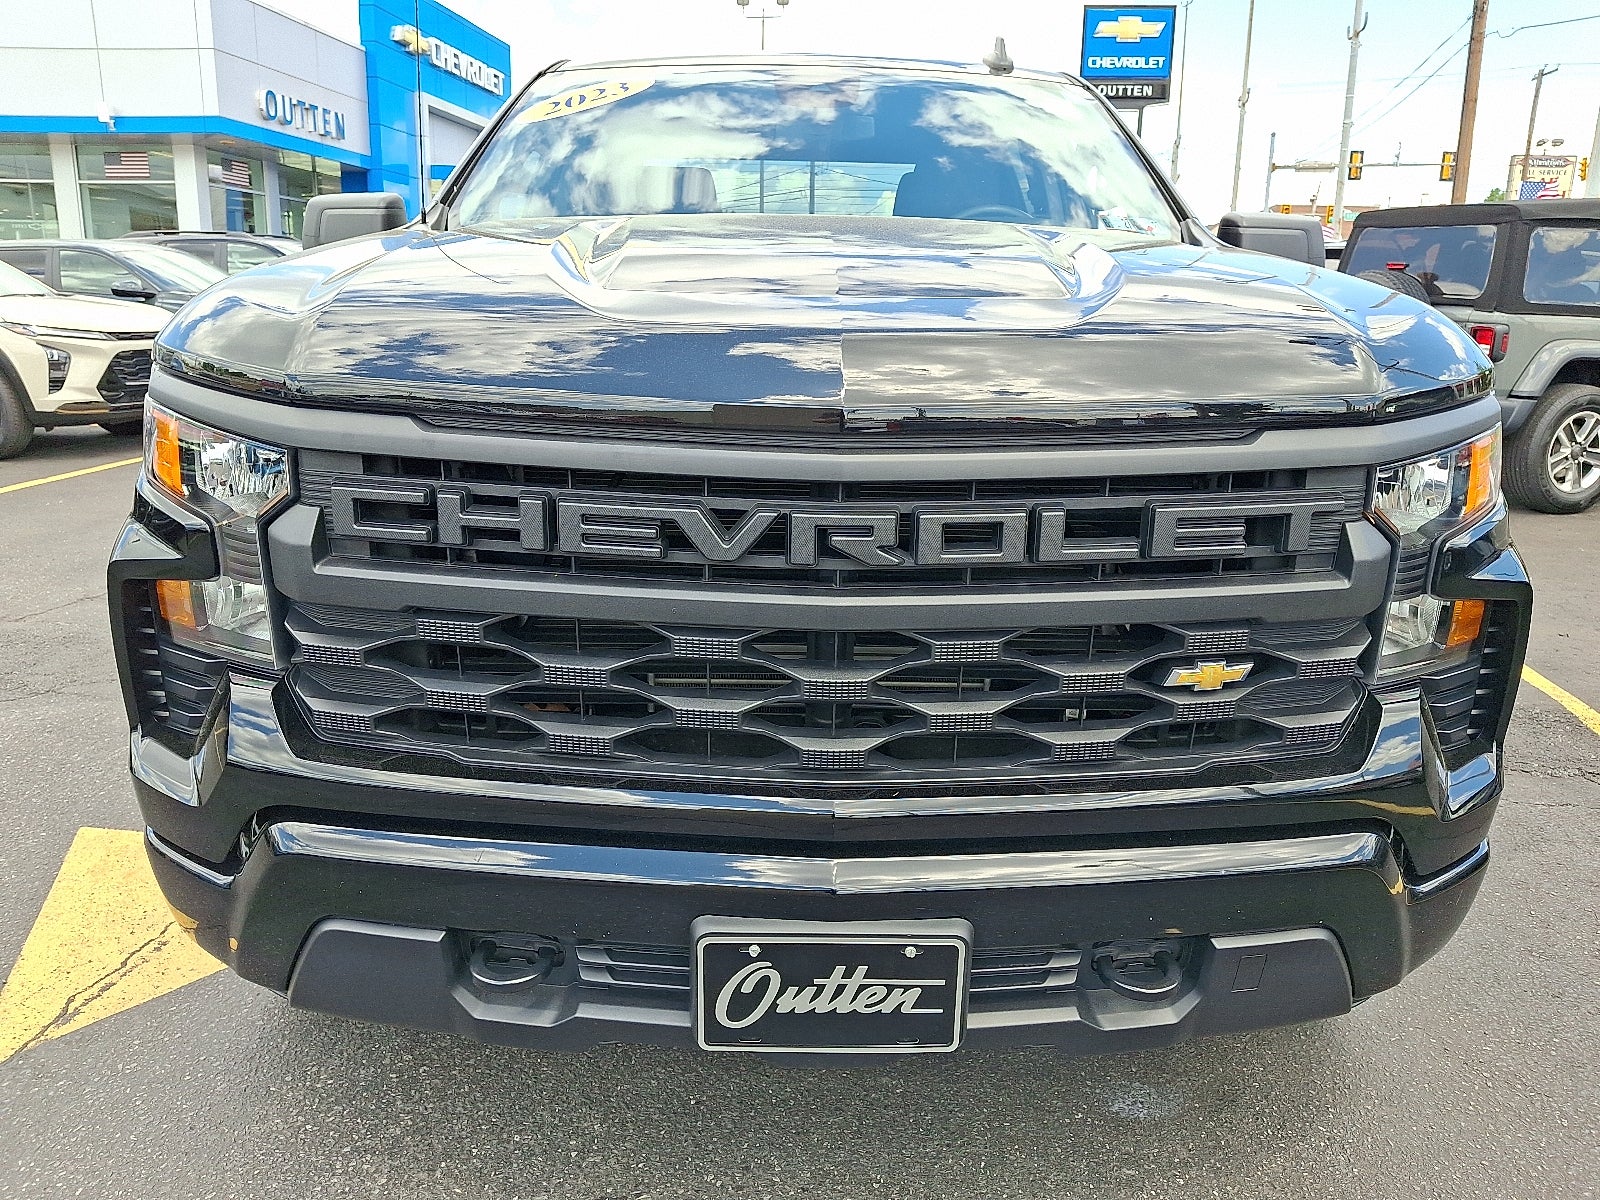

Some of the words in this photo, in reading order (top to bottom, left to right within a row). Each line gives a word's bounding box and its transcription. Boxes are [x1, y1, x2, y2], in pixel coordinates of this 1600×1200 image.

[429, 36, 506, 97] CHEVROLET
[1087, 56, 1167, 69] CHEVROLET
[257, 89, 346, 140] OUTTEN
[543, 82, 630, 116] 2023
[1097, 84, 1153, 97] OUTTEN
[330, 478, 1346, 567] CHEVROLET
[715, 961, 946, 1029] Outten
